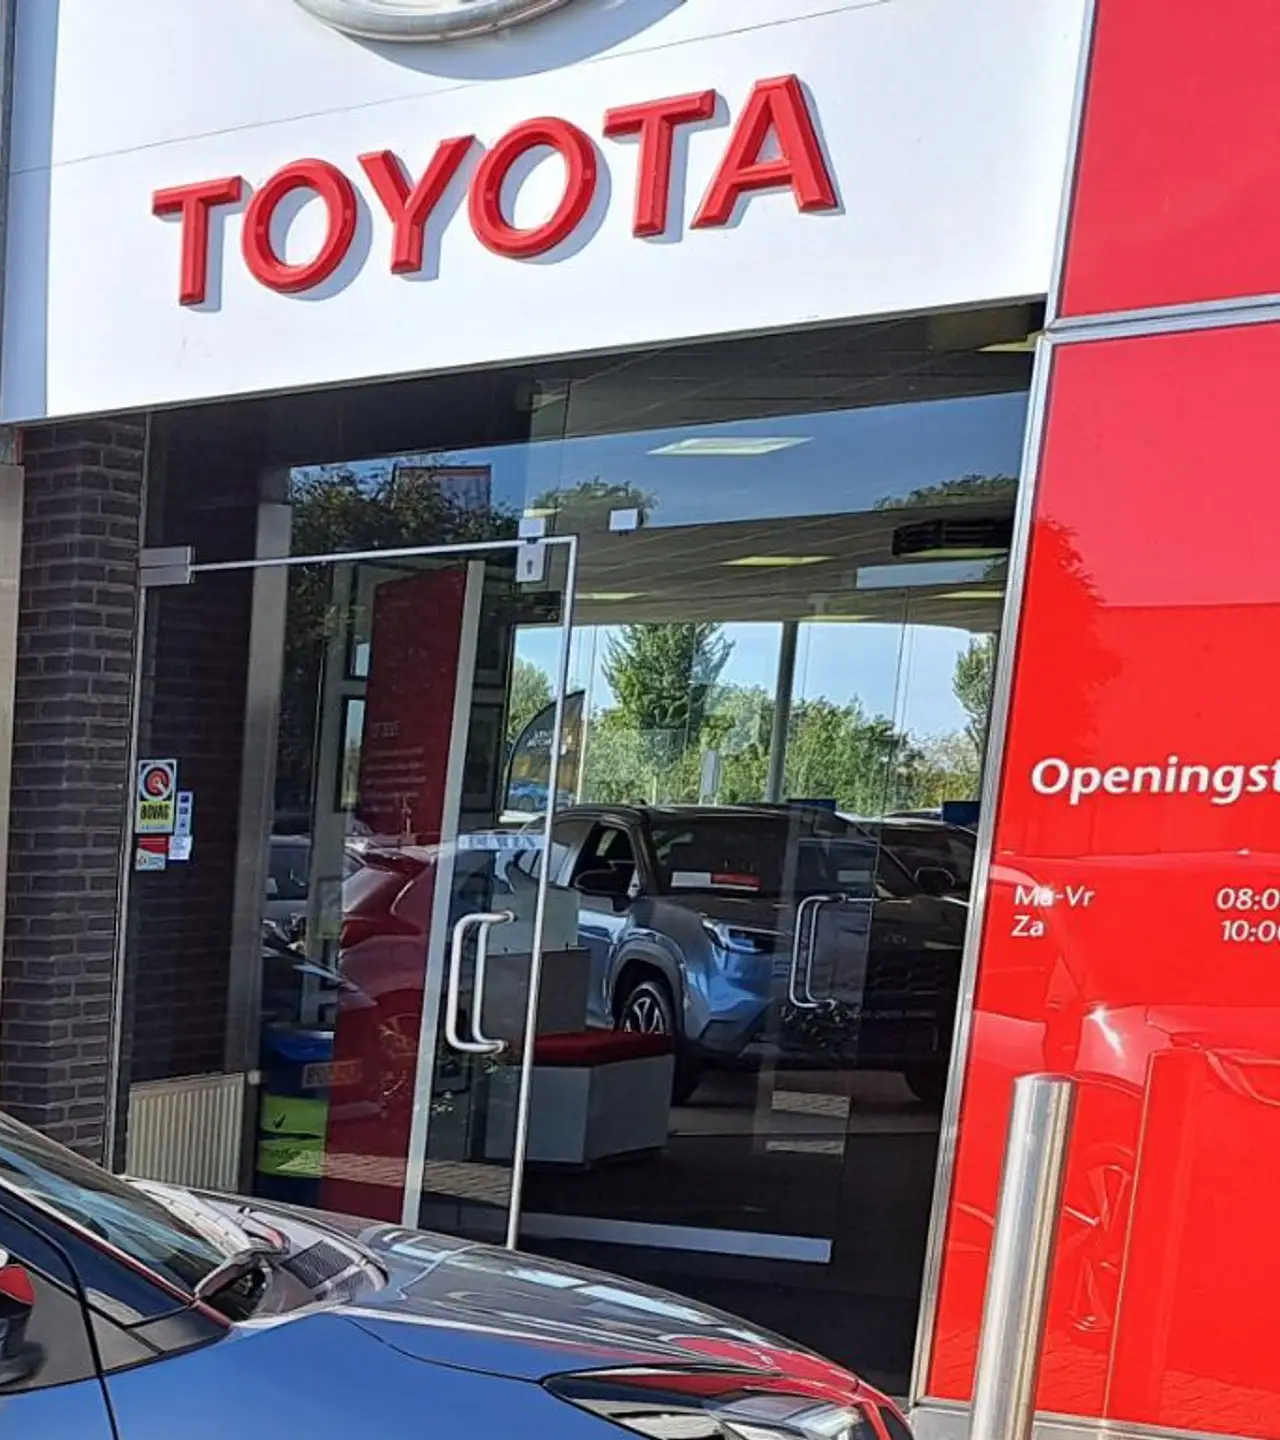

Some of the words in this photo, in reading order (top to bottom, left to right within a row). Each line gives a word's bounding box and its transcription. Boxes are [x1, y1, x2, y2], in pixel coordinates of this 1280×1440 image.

[152, 73, 839, 307] TOYOTA
[1011, 915, 1044, 937] Za
[1220, 919, 1280, 943] 10:0
